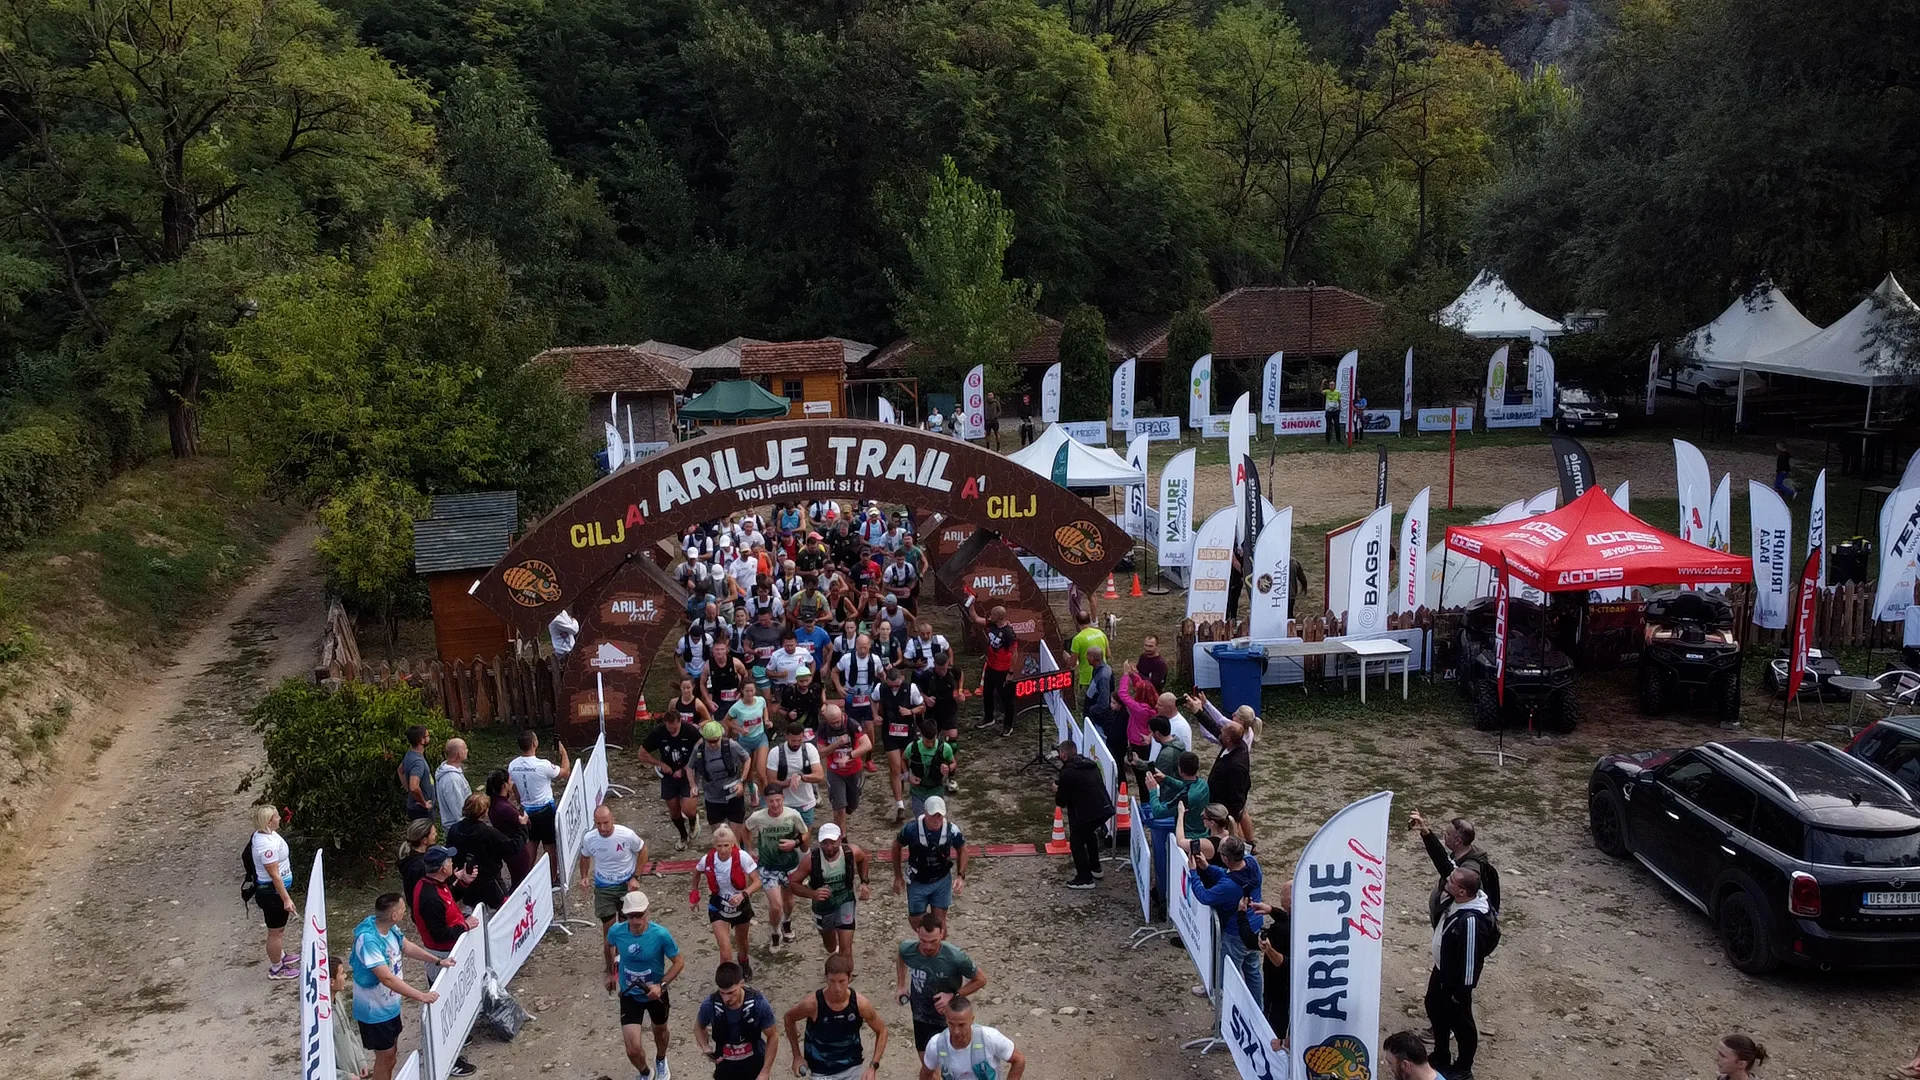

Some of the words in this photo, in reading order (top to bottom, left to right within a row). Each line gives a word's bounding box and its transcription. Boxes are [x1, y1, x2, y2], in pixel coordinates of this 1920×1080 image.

[1425, 414, 1465, 424] СТЕФН
[657, 437, 809, 513] ARILJE
[828, 437, 953, 492] TRAIL
[961, 474, 986, 499] A1
[735, 484, 764, 502] Tvoj
[765, 481, 803, 497] jedini
[805, 478, 835, 492] limit
[838, 479, 852, 492] si
[853, 480, 865, 493] ti
[625, 499, 649, 528] A1
[986, 494, 1038, 519] CILJ
[1166, 479, 1181, 543] NATURE
[570, 519, 626, 548] CILJ
[1586, 531, 1662, 546] AODES
[1600, 545, 1635, 558] BEYOND
[972, 574, 1012, 588] ARILJE
[1364, 540, 1379, 606] BAGS
[1557, 567, 1624, 585] AODES
[988, 584, 1016, 597] trail
[611, 600, 654, 613] ARILJE
[628, 609, 658, 622] trail
[1015, 672, 1072, 696] 00:11:26
[1347, 838, 1385, 941] trail
[1870, 893, 1882, 903] UE
[510, 908, 538, 958] ANT
[1306, 861, 1351, 1021] ARILJE
[440, 948, 477, 1045] KVADER
[1334, 1040, 1365, 1063] ARILJE
